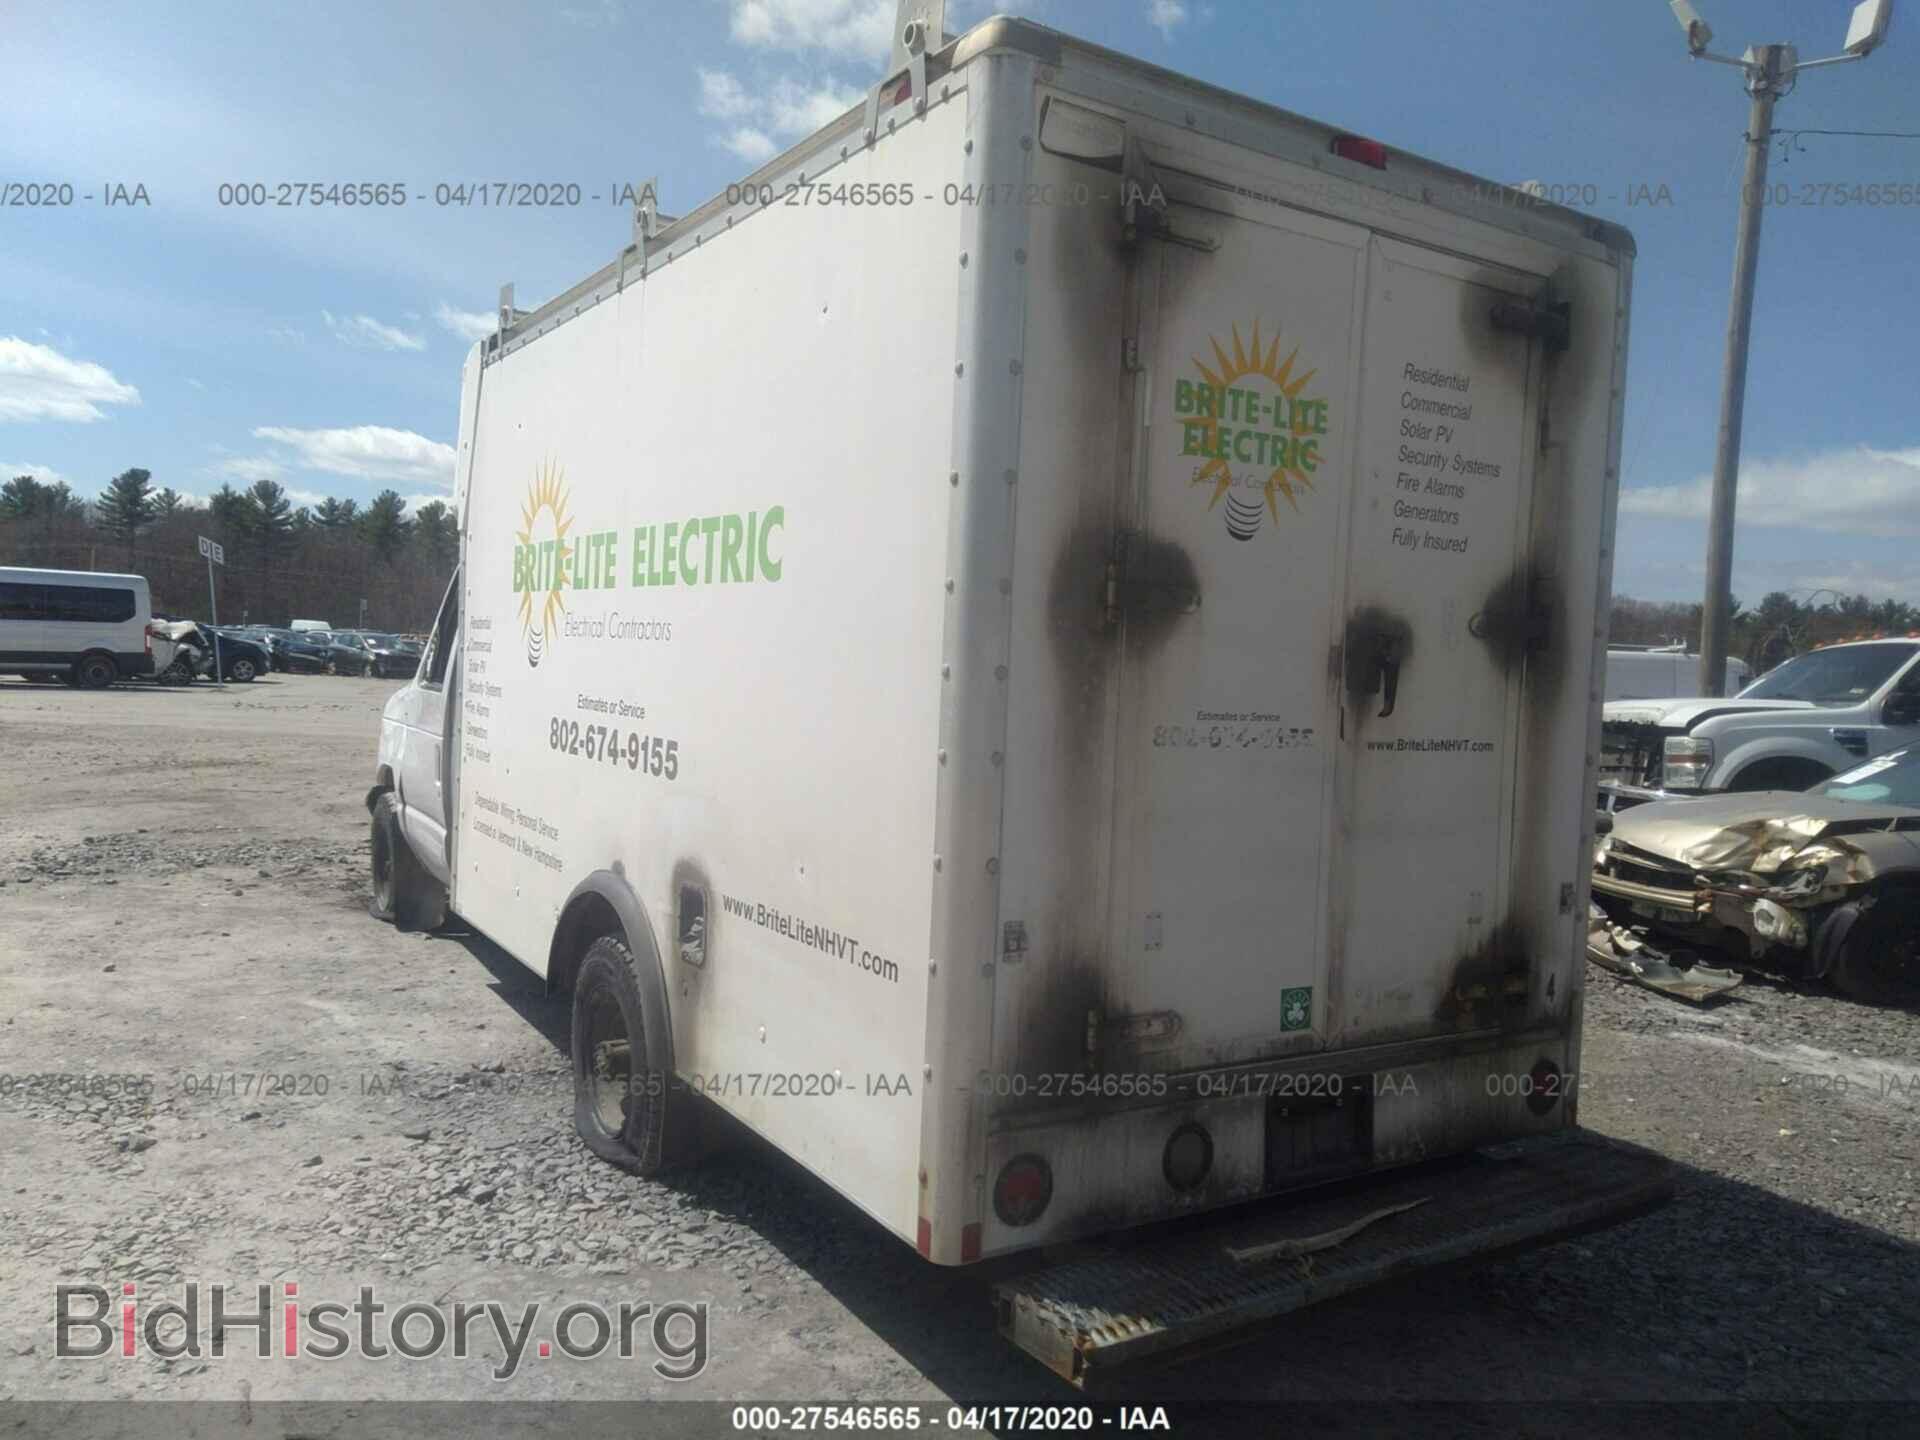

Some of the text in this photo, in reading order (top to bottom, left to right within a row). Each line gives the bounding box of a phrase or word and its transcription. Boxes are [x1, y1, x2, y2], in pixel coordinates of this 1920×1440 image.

[1403, 362, 1470, 393] Residential
[1174, 379, 1329, 435] BRITE-LITE
[1401, 391, 1473, 421] Commercial
[1400, 418, 1454, 443] Solar PV
[1183, 421, 1319, 473] ELECTRIC
[1398, 444, 1501, 478] Security Systems
[1396, 472, 1465, 500] Fire Alarms
[1393, 499, 1460, 526] Generators
[512, 505, 785, 592] BRITE-LITE ELECTRIC
[1392, 527, 1469, 553] Fully Insured
[564, 611, 673, 641] Electrical Contractors
[577, 693, 646, 720] Estimates or Service
[550, 716, 679, 781] 802-674-9155
[1366, 737, 1495, 753] www.BriteLiteNHVT.com
[722, 894, 900, 983] www.BriteLiteNHVT.com
